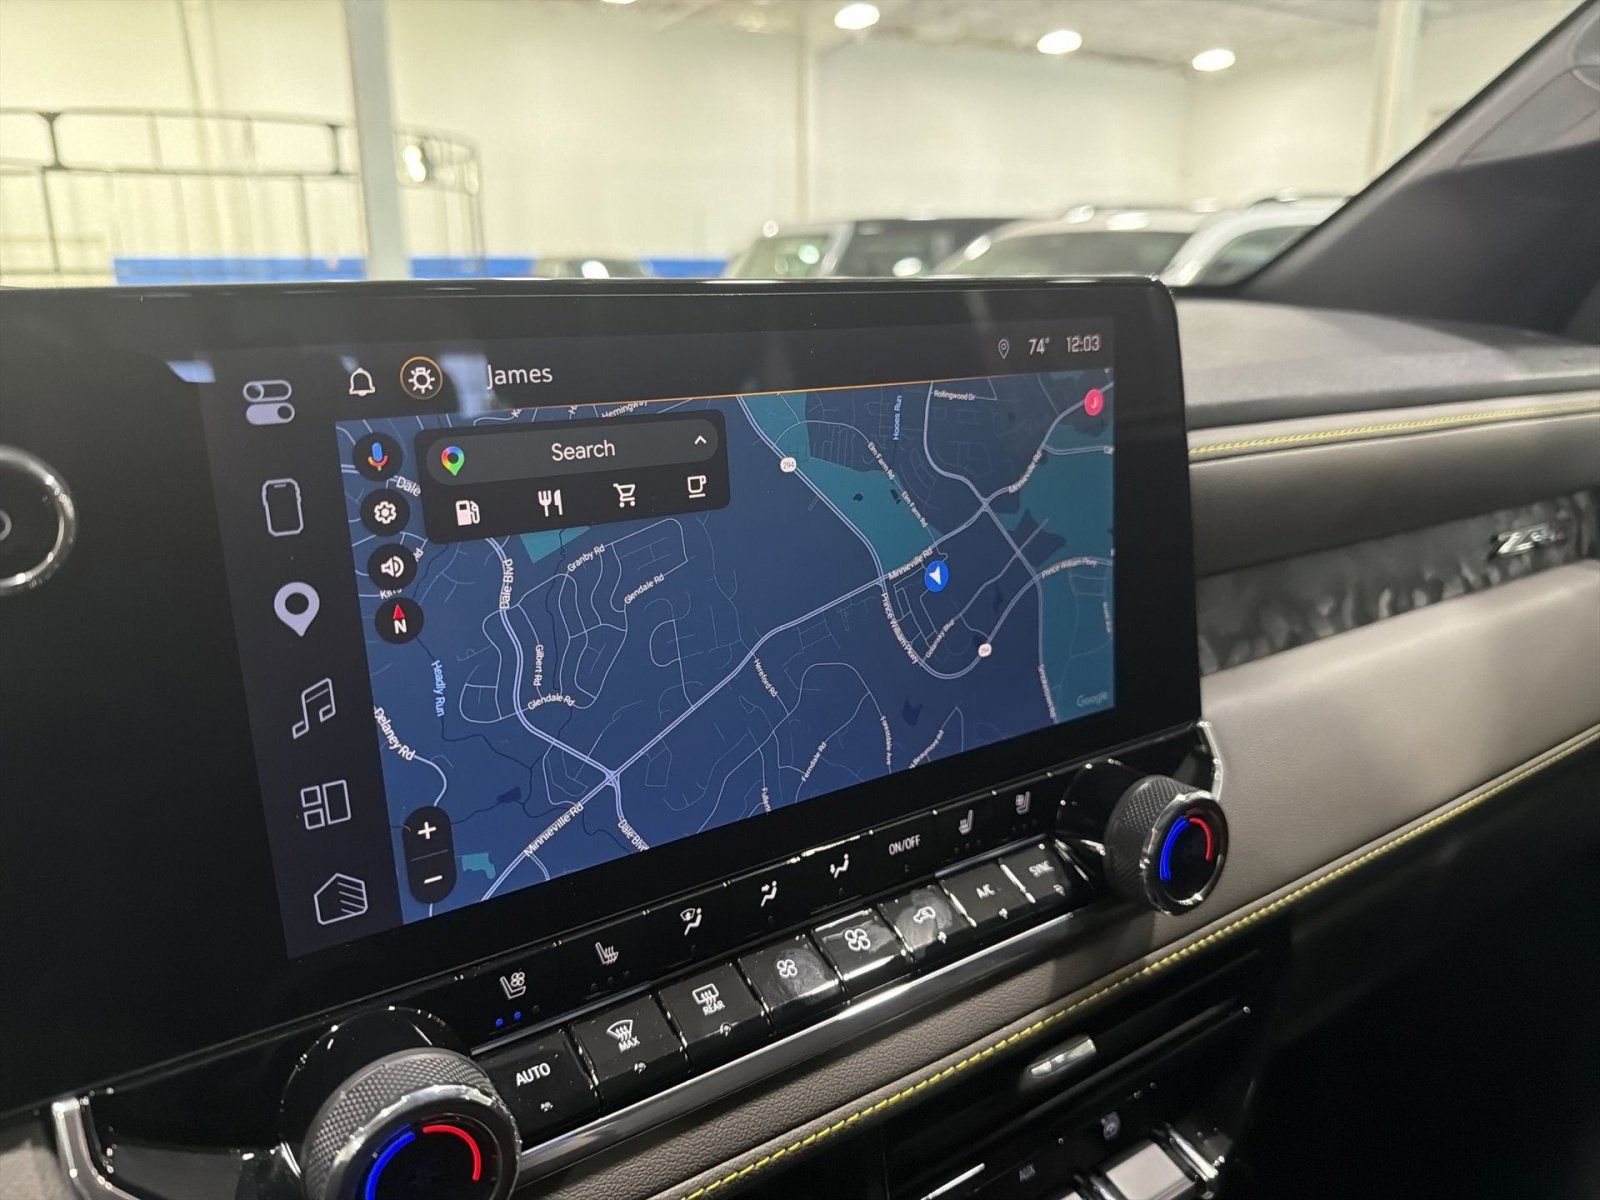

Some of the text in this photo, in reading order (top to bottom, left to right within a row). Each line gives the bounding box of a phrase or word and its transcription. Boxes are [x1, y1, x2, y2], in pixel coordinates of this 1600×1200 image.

[1028, 337, 1050, 355] 74°
[1066, 335, 1100, 352] 12:03
[487, 364, 553, 390] James
[934, 389, 976, 401] Rollingwood Dr
[893, 395, 902, 440] Hooes Run
[551, 439, 616, 461] Search
[868, 442, 896, 480] Elm Farm Rd
[1033, 450, 1042, 463] Rd
[782, 460, 795, 470] 294
[396, 476, 421, 497] Dale
[901, 491, 928, 528] Elm Farm Rd
[567, 543, 605, 572] Granby Rd
[888, 546, 933, 581] Minnieville Rd
[500, 558, 514, 610] Dale Blvd
[624, 572, 665, 604] Glendale Rd
[394, 619, 407, 634] N
[881, 592, 918, 664] Prince William Pkwy
[533, 644, 544, 686] Gilbert Rd
[754, 658, 778, 697] Hereford Rd
[431, 660, 446, 717] Headly Run
[1077, 691, 1108, 707] Google
[527, 693, 576, 711] Glendale Rd
[374, 706, 416, 761] Delaney Rd
[880, 715, 892, 751] Forestdale
[936, 729, 944, 740] Rd
[801, 741, 827, 782] Ferndale Rd
[523, 801, 584, 857] Minnieville Rd
[618, 819, 635, 839] Dale
[888, 834, 921, 856] ON/OFF
[702, 1000, 725, 1016] REAR
[618, 1036, 641, 1053] MAX
[515, 1062, 551, 1087] AUTO
